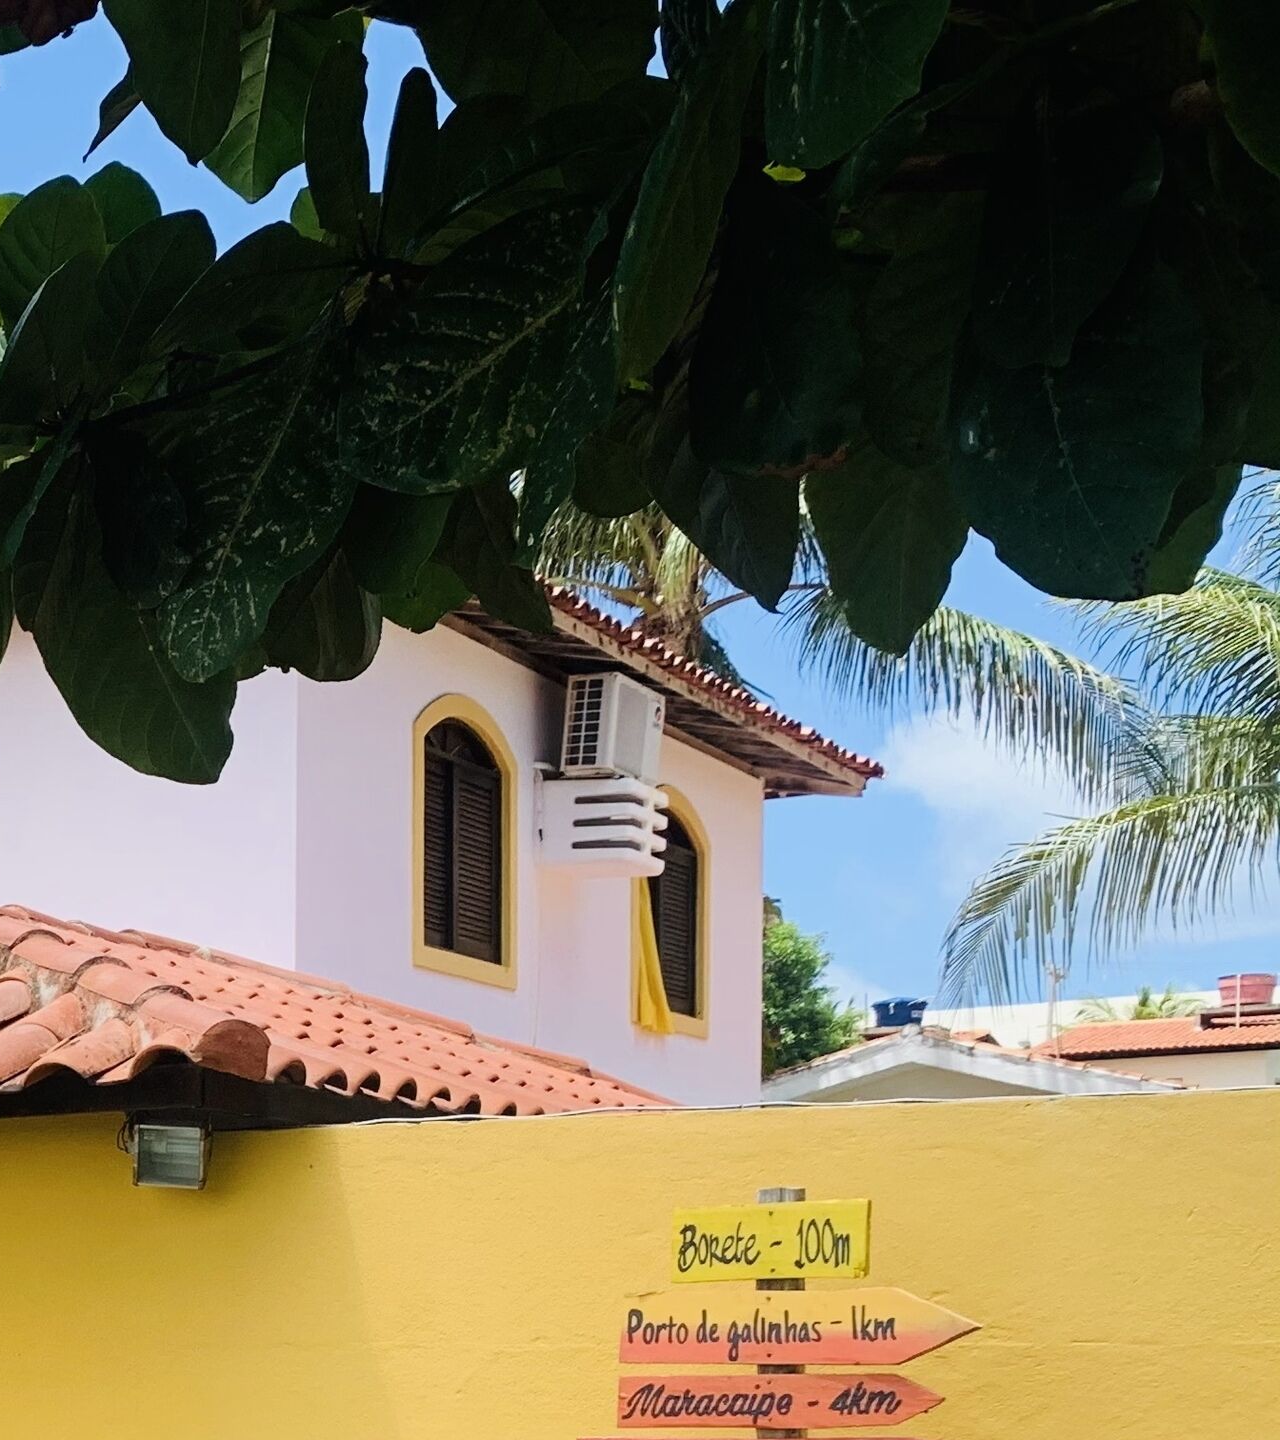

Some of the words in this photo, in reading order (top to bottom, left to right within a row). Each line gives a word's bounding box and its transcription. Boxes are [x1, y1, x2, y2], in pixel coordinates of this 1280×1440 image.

[794, 1218, 850, 1269] 100m
[627, 1308, 688, 1344] Porto
[696, 1309, 720, 1344] de
[727, 1308, 823, 1361] galinhas
[852, 1305, 897, 1342] 1km
[622, 1382, 793, 1425] Maracaipe
[829, 1381, 902, 1416] 4km
